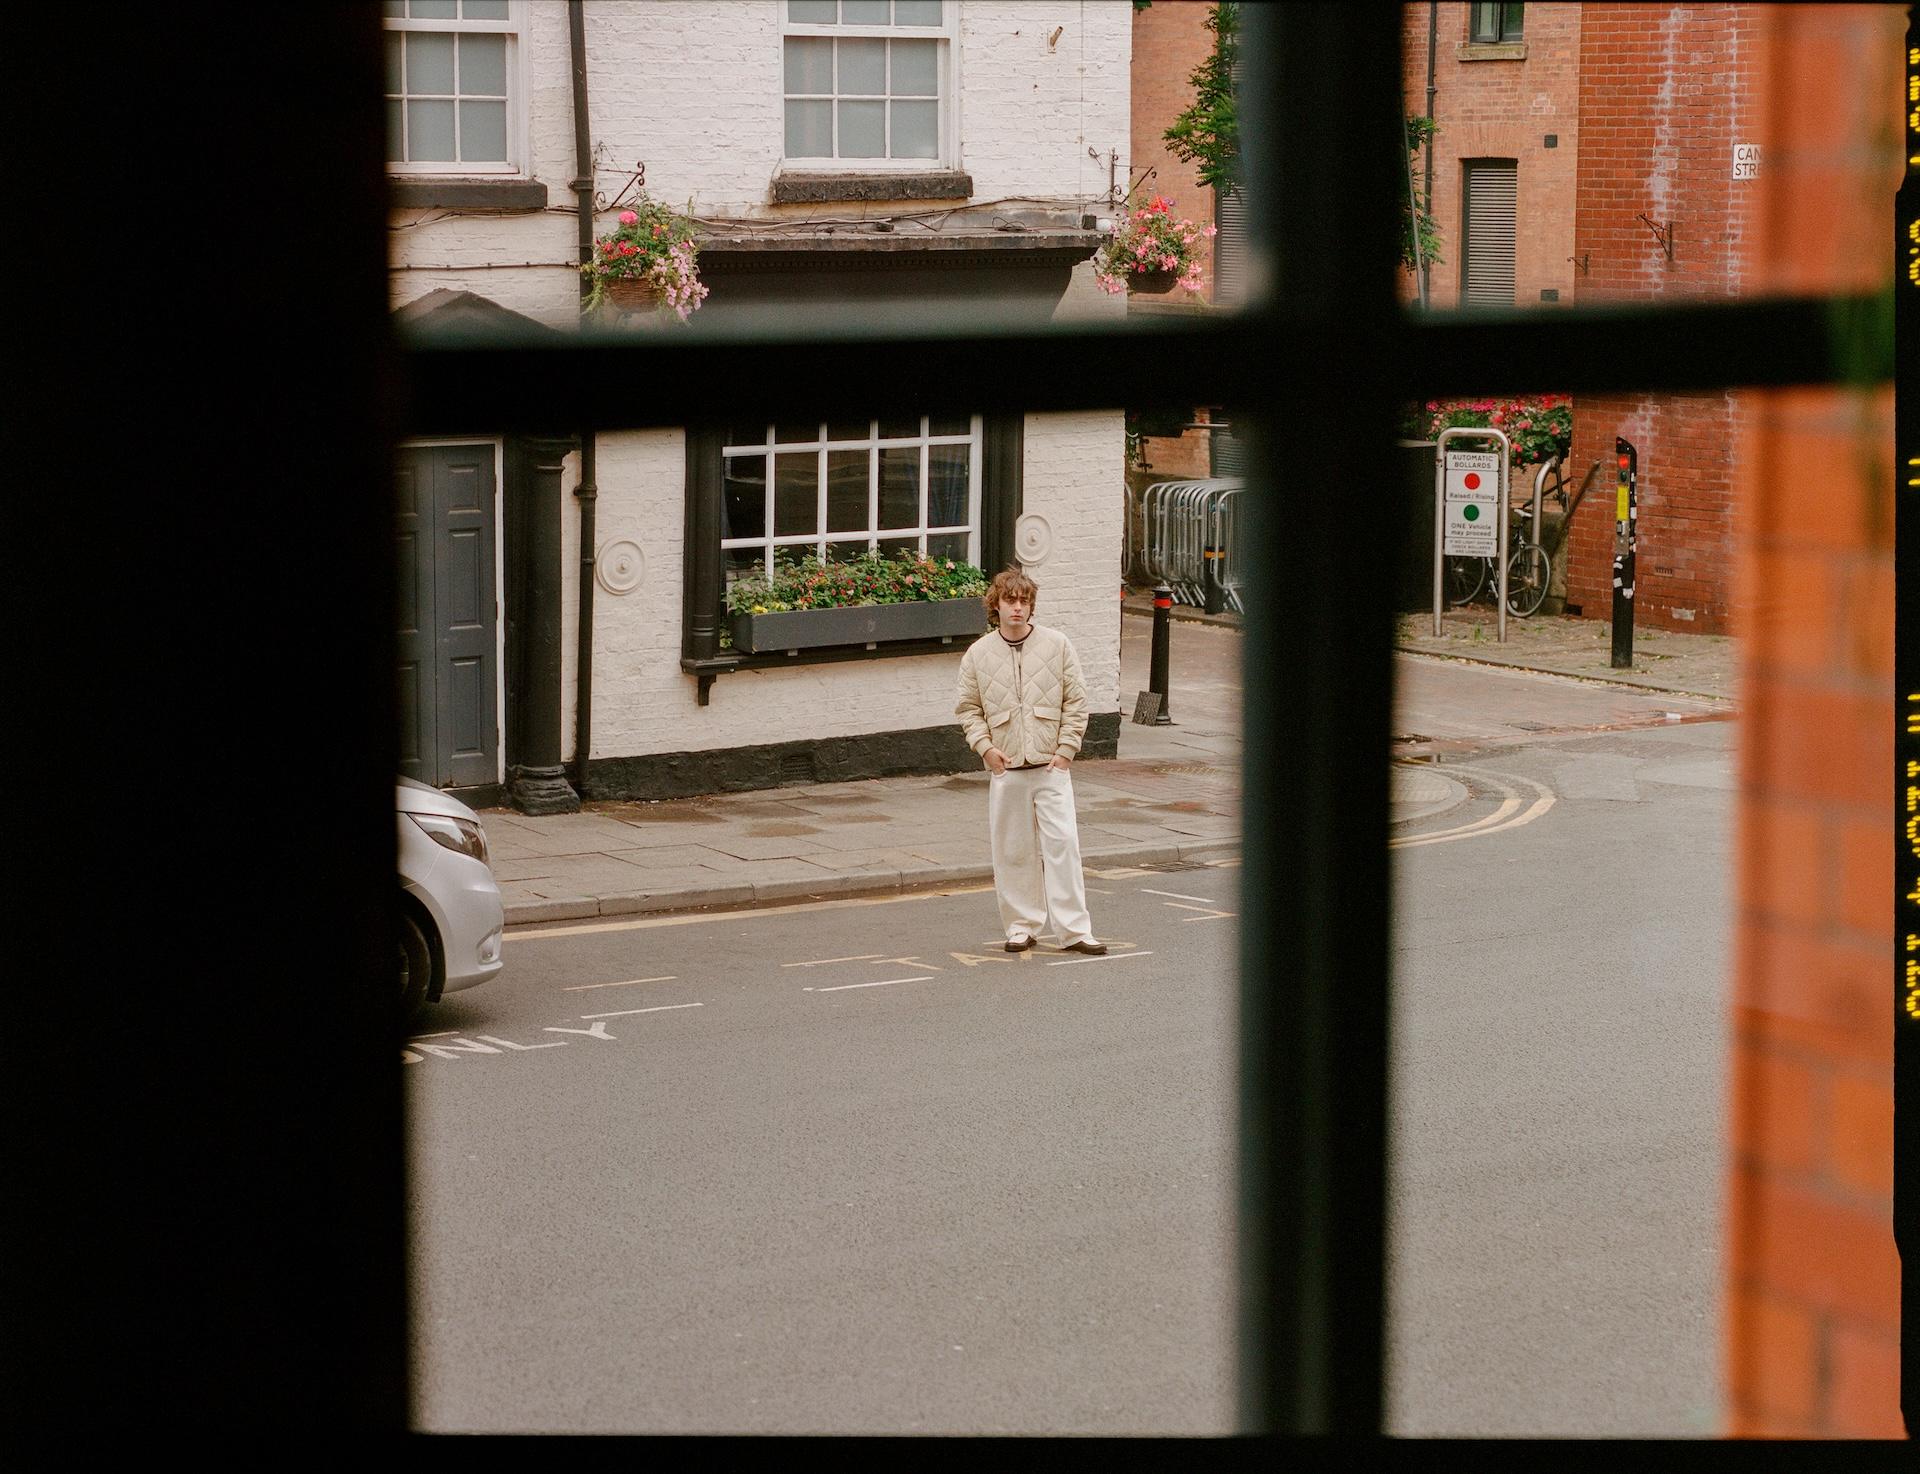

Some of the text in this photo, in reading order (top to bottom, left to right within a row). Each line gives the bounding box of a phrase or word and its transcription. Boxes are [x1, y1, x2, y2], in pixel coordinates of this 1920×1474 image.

[1452, 454, 1493, 462] AUTOMATIC
[1454, 461, 1491, 469] BOLLARDS
[1475, 493, 1495, 501] Rising
